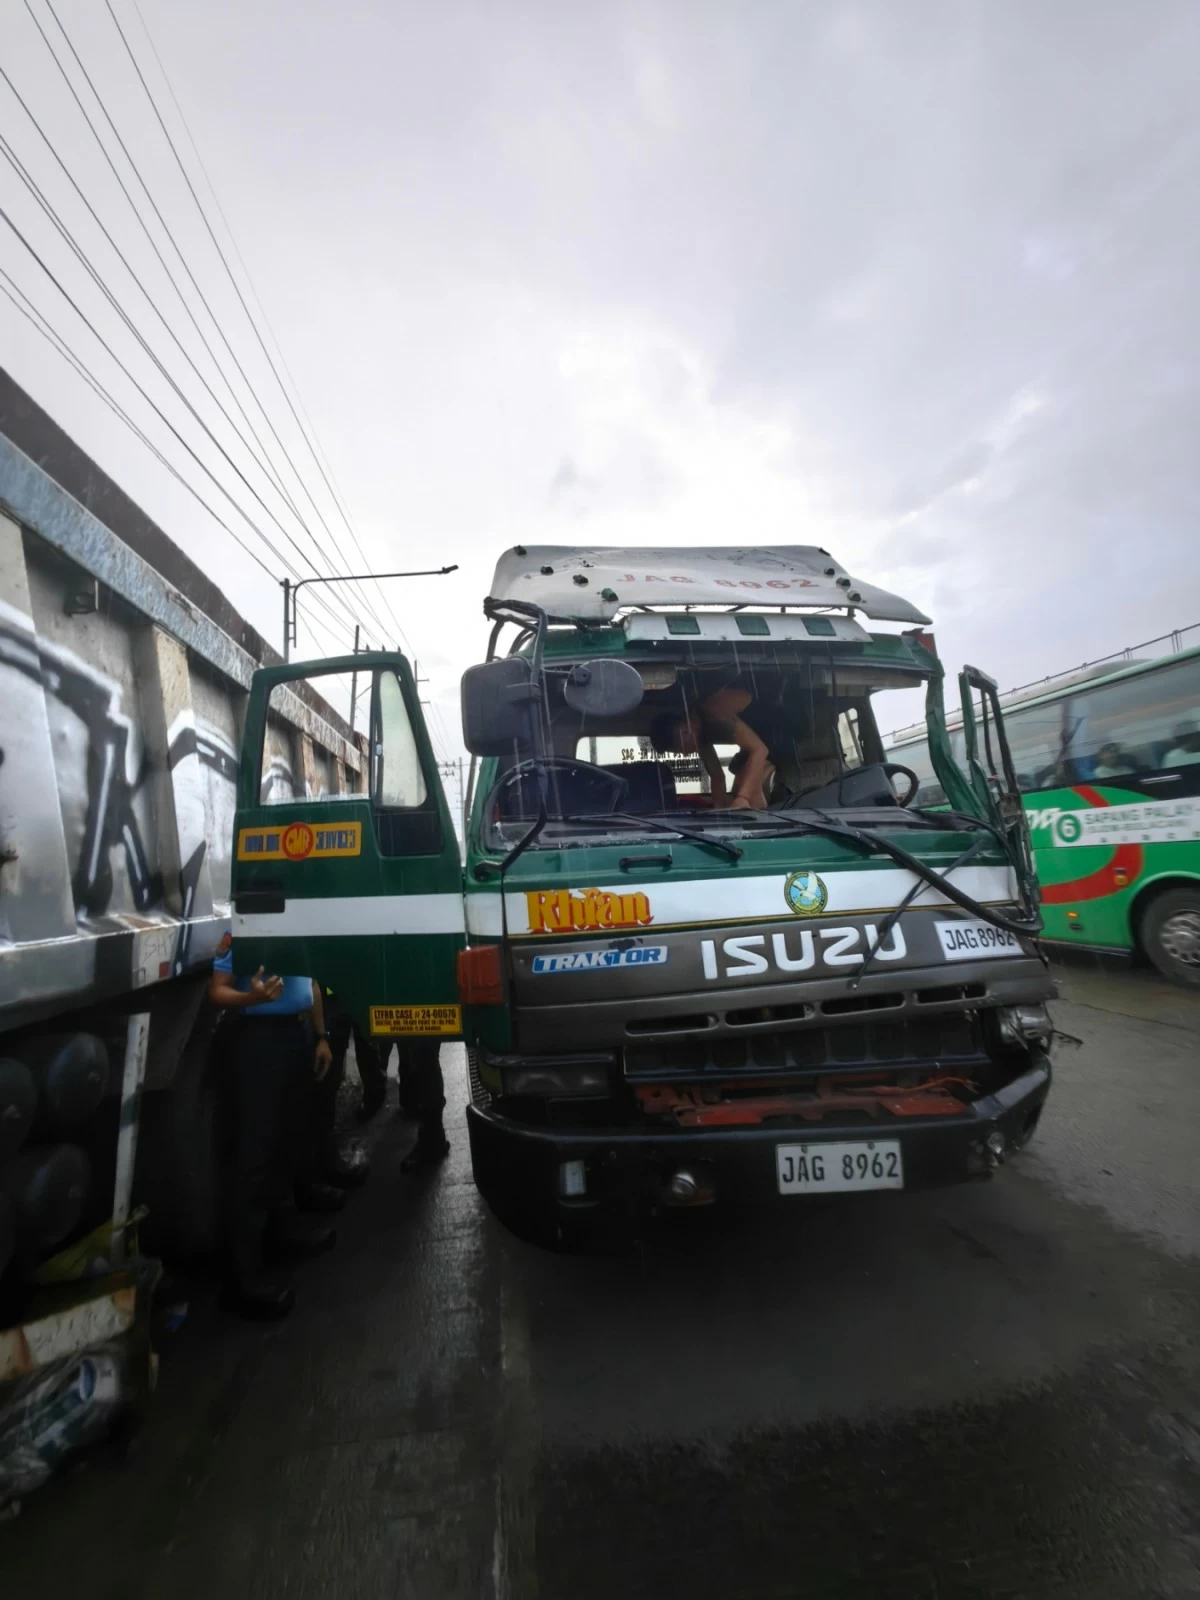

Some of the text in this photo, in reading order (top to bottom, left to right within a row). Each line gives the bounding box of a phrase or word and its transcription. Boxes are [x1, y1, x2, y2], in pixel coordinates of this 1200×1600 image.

[616, 573, 820, 589] JAG 8962
[701, 921, 908, 980] ISUZU
[945, 927, 1015, 950] JAG 8962
[538, 947, 662, 972] TRAKTOR
[395, 1009, 413, 1019] CASE
[782, 1151, 899, 1183] JAG 8962
